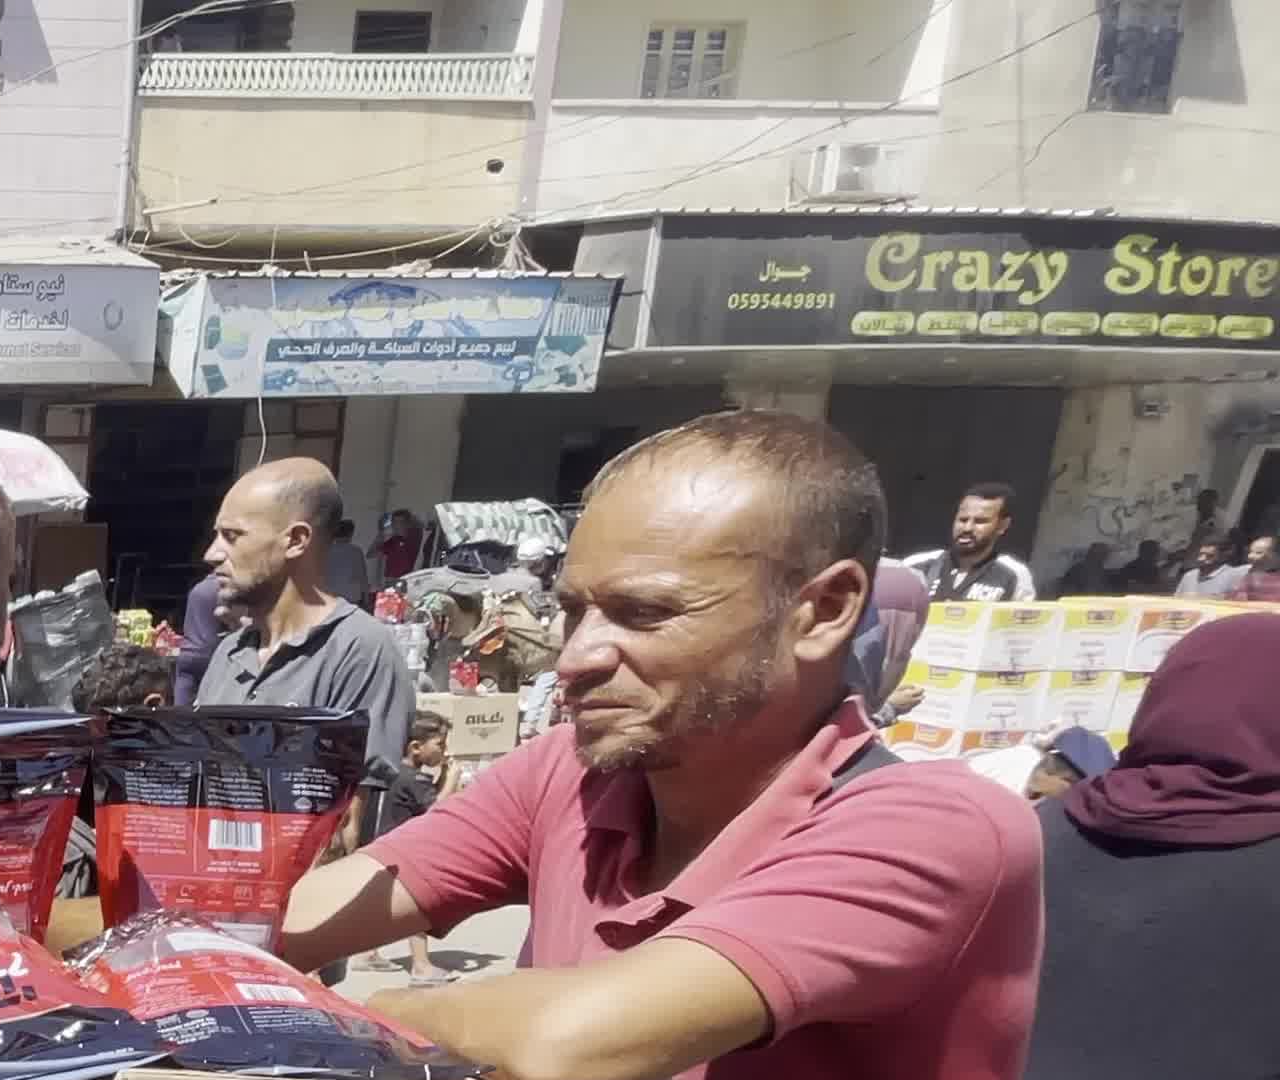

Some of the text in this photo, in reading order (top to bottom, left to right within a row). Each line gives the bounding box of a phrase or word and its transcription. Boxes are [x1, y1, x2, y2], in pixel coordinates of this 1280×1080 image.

[865, 232, 1278, 304] Crazy Store
[727, 292, 835, 310] 0595449891
